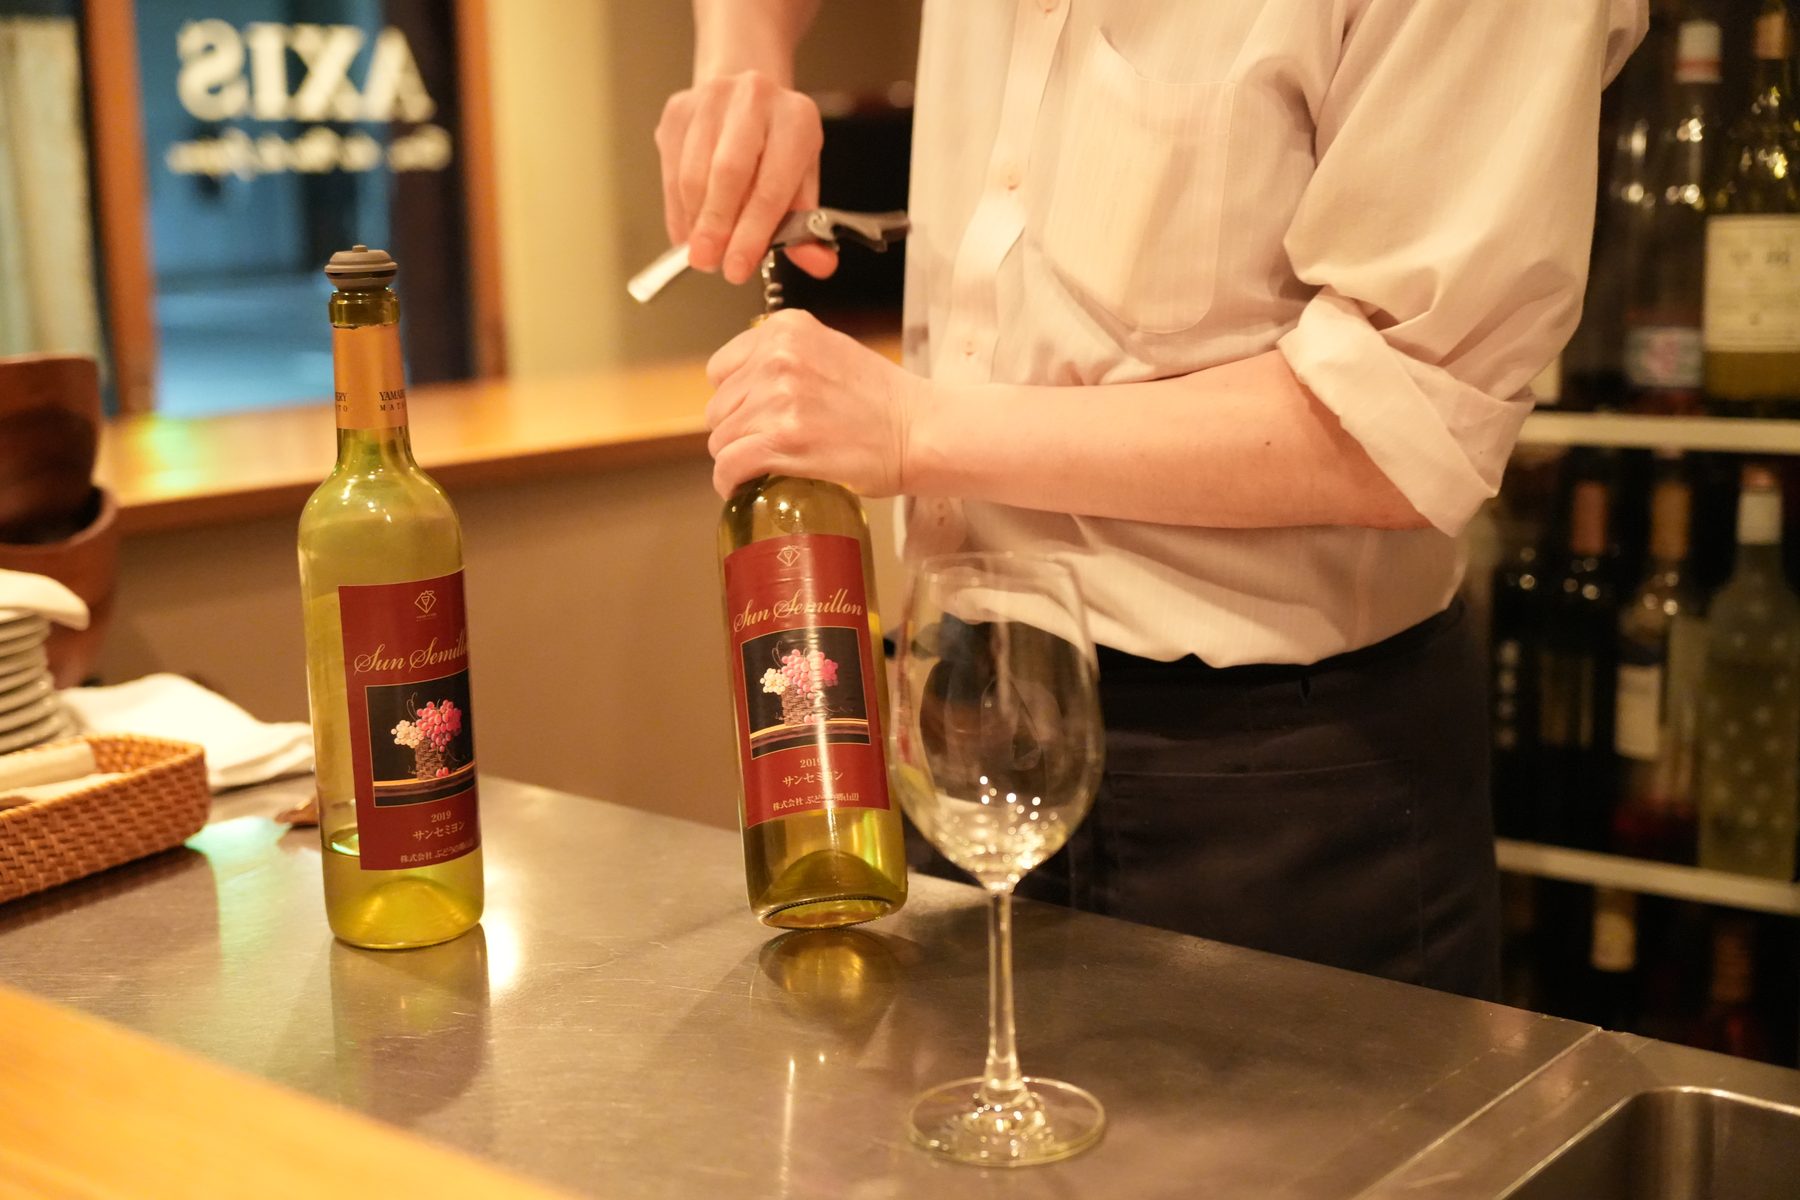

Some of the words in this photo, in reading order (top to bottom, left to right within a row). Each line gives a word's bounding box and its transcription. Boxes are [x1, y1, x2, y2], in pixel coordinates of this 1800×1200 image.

[733, 599, 770, 633] Sun
[773, 588, 863, 622] Semillon
[353, 643, 406, 676] Sun
[782, 770, 843, 788] サンセミン
[431, 810, 452, 823] 2019
[412, 820, 465, 841] サンセミヨン
